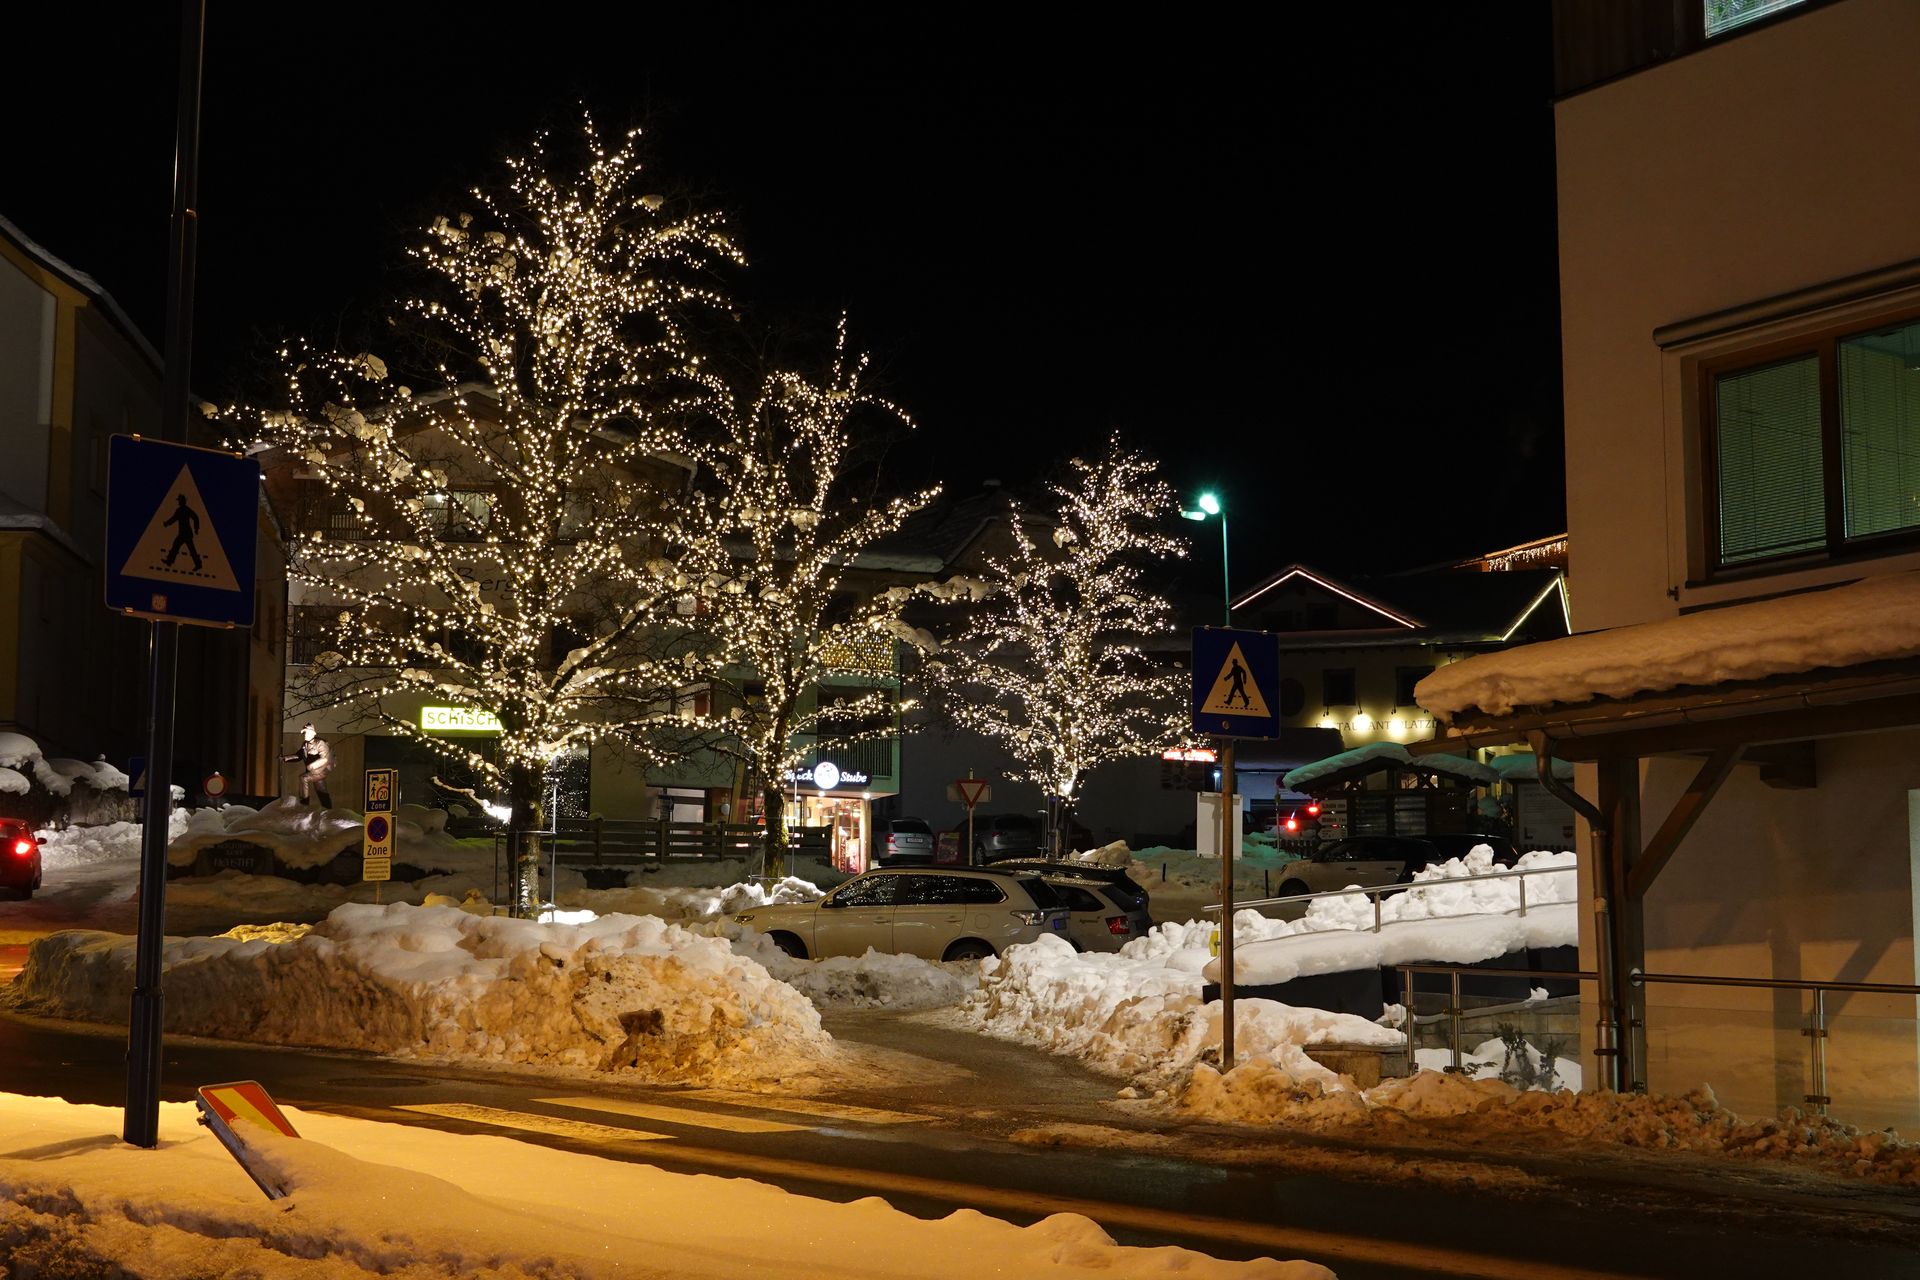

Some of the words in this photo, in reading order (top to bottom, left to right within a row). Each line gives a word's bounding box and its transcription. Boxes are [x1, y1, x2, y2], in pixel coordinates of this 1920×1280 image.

[840, 771, 867, 782] Stube
[380, 790, 387, 799] 20
[370, 801, 386, 810] Zone
[367, 845, 388, 856] Zone
